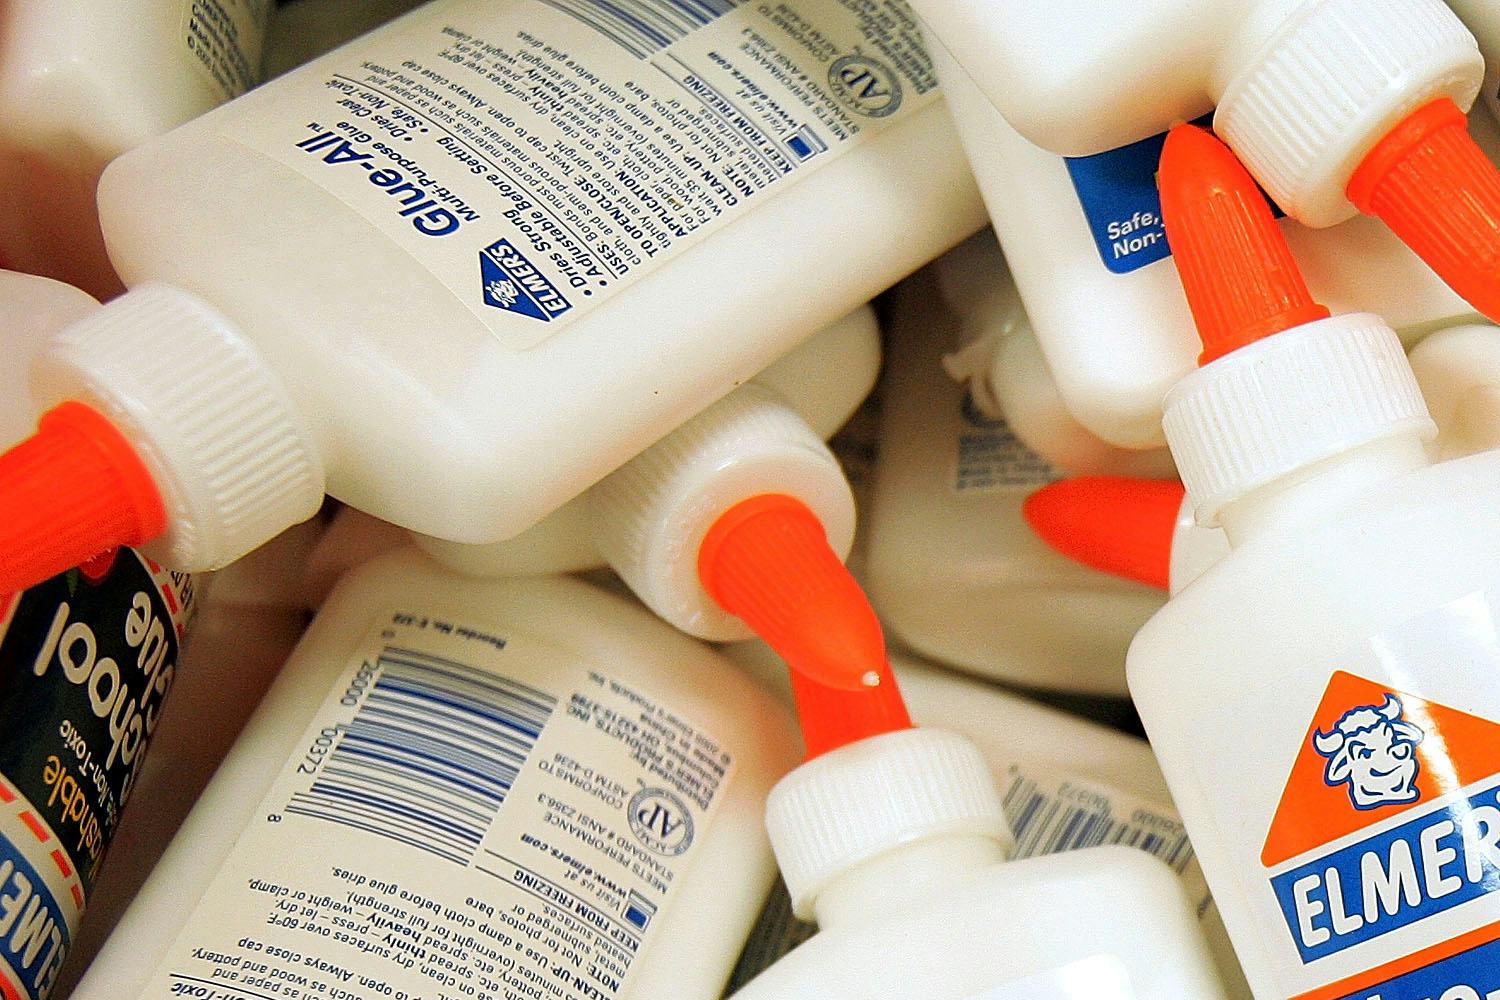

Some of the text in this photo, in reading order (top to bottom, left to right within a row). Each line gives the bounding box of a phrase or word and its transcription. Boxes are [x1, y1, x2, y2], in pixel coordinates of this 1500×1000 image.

[337, 122, 480, 221] Multi-Purpose Glue
[436, 137, 603, 275] Adjustable Before Setting
[1107, 208, 1160, 241] Safe,
[503, 210, 586, 287] Dries Strong
[487, 238, 571, 317] ELMER'S
[211, 964, 239, 983] and
[240, 976, 282, 992] paper
[281, 985, 300, 1000] as
